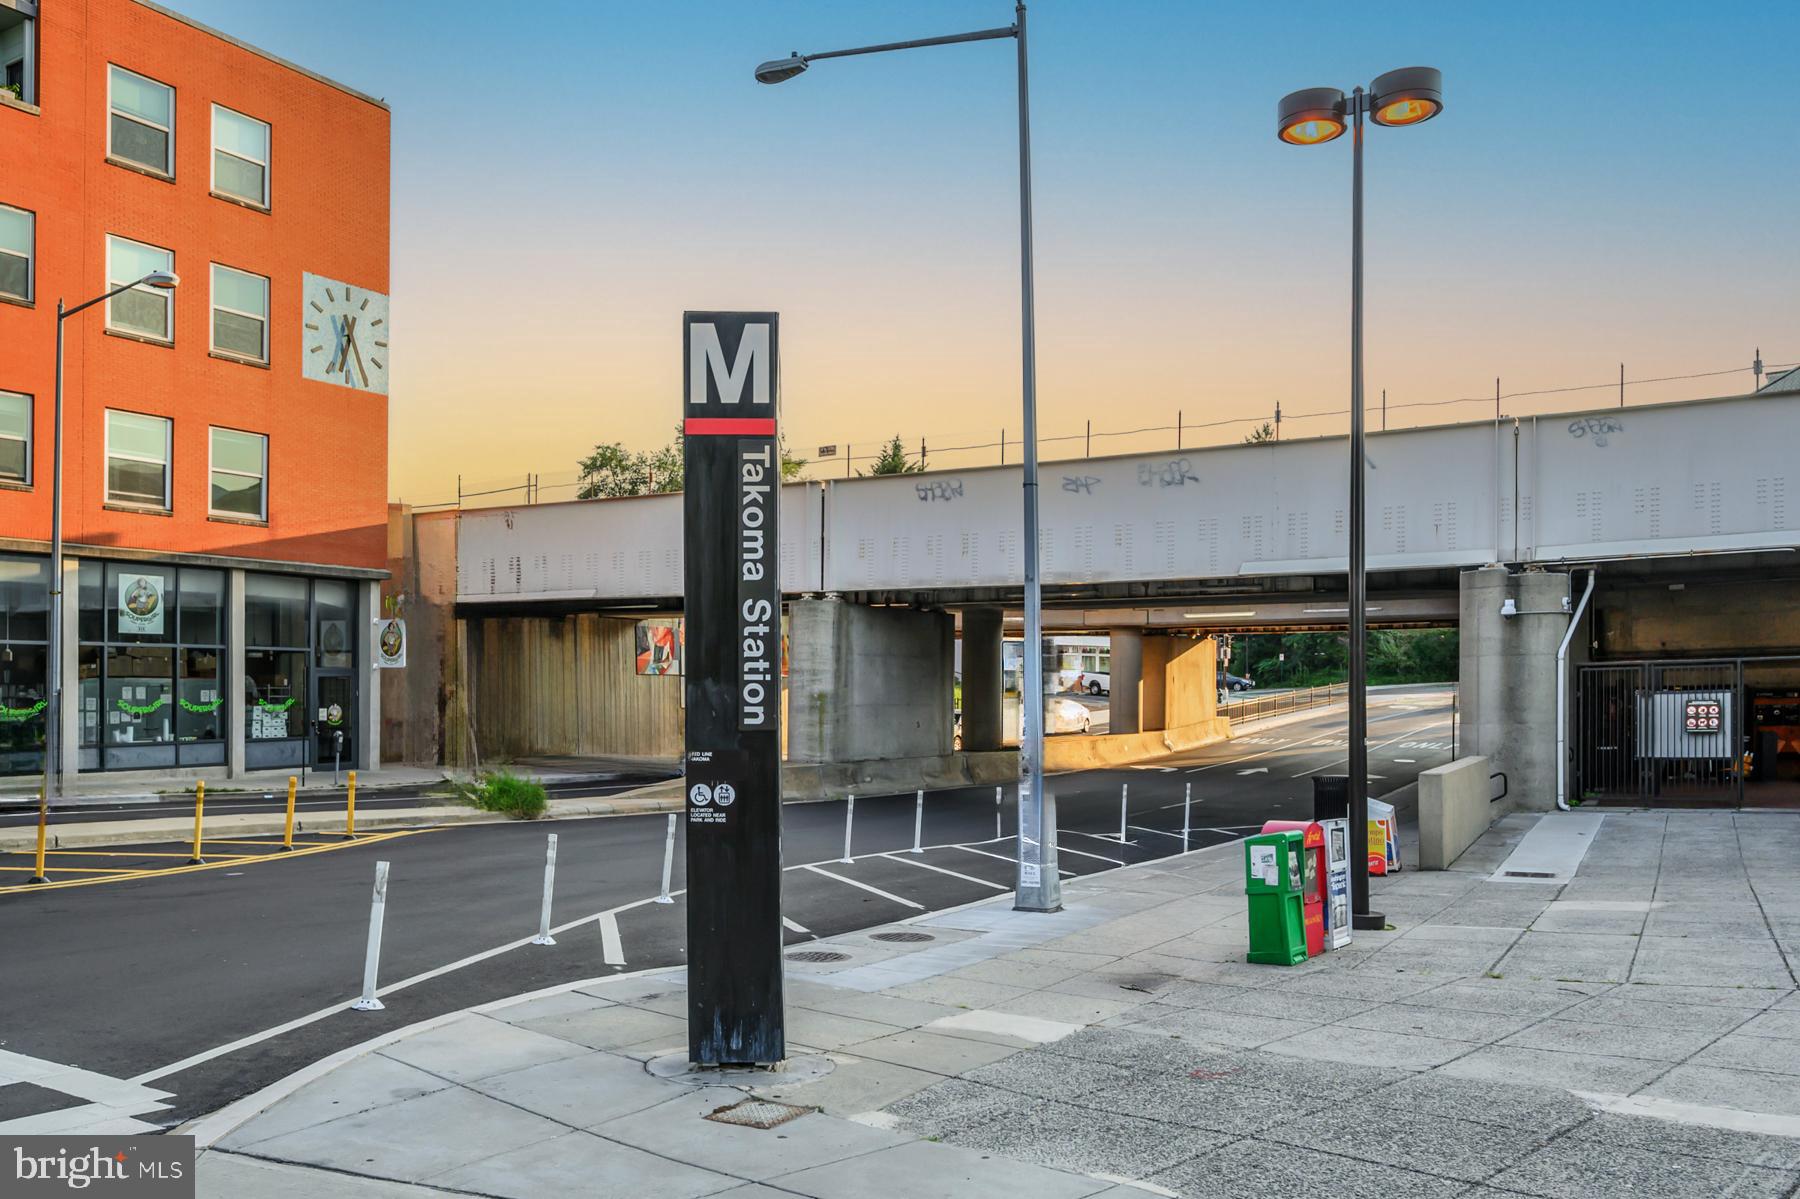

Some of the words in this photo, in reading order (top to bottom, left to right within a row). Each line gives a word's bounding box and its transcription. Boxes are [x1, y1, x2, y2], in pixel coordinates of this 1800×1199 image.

[689, 322, 771, 404] M
[741, 445, 771, 582] Takoma
[741, 598, 771, 726] Station
[1399, 741, 1460, 750] ONLY
